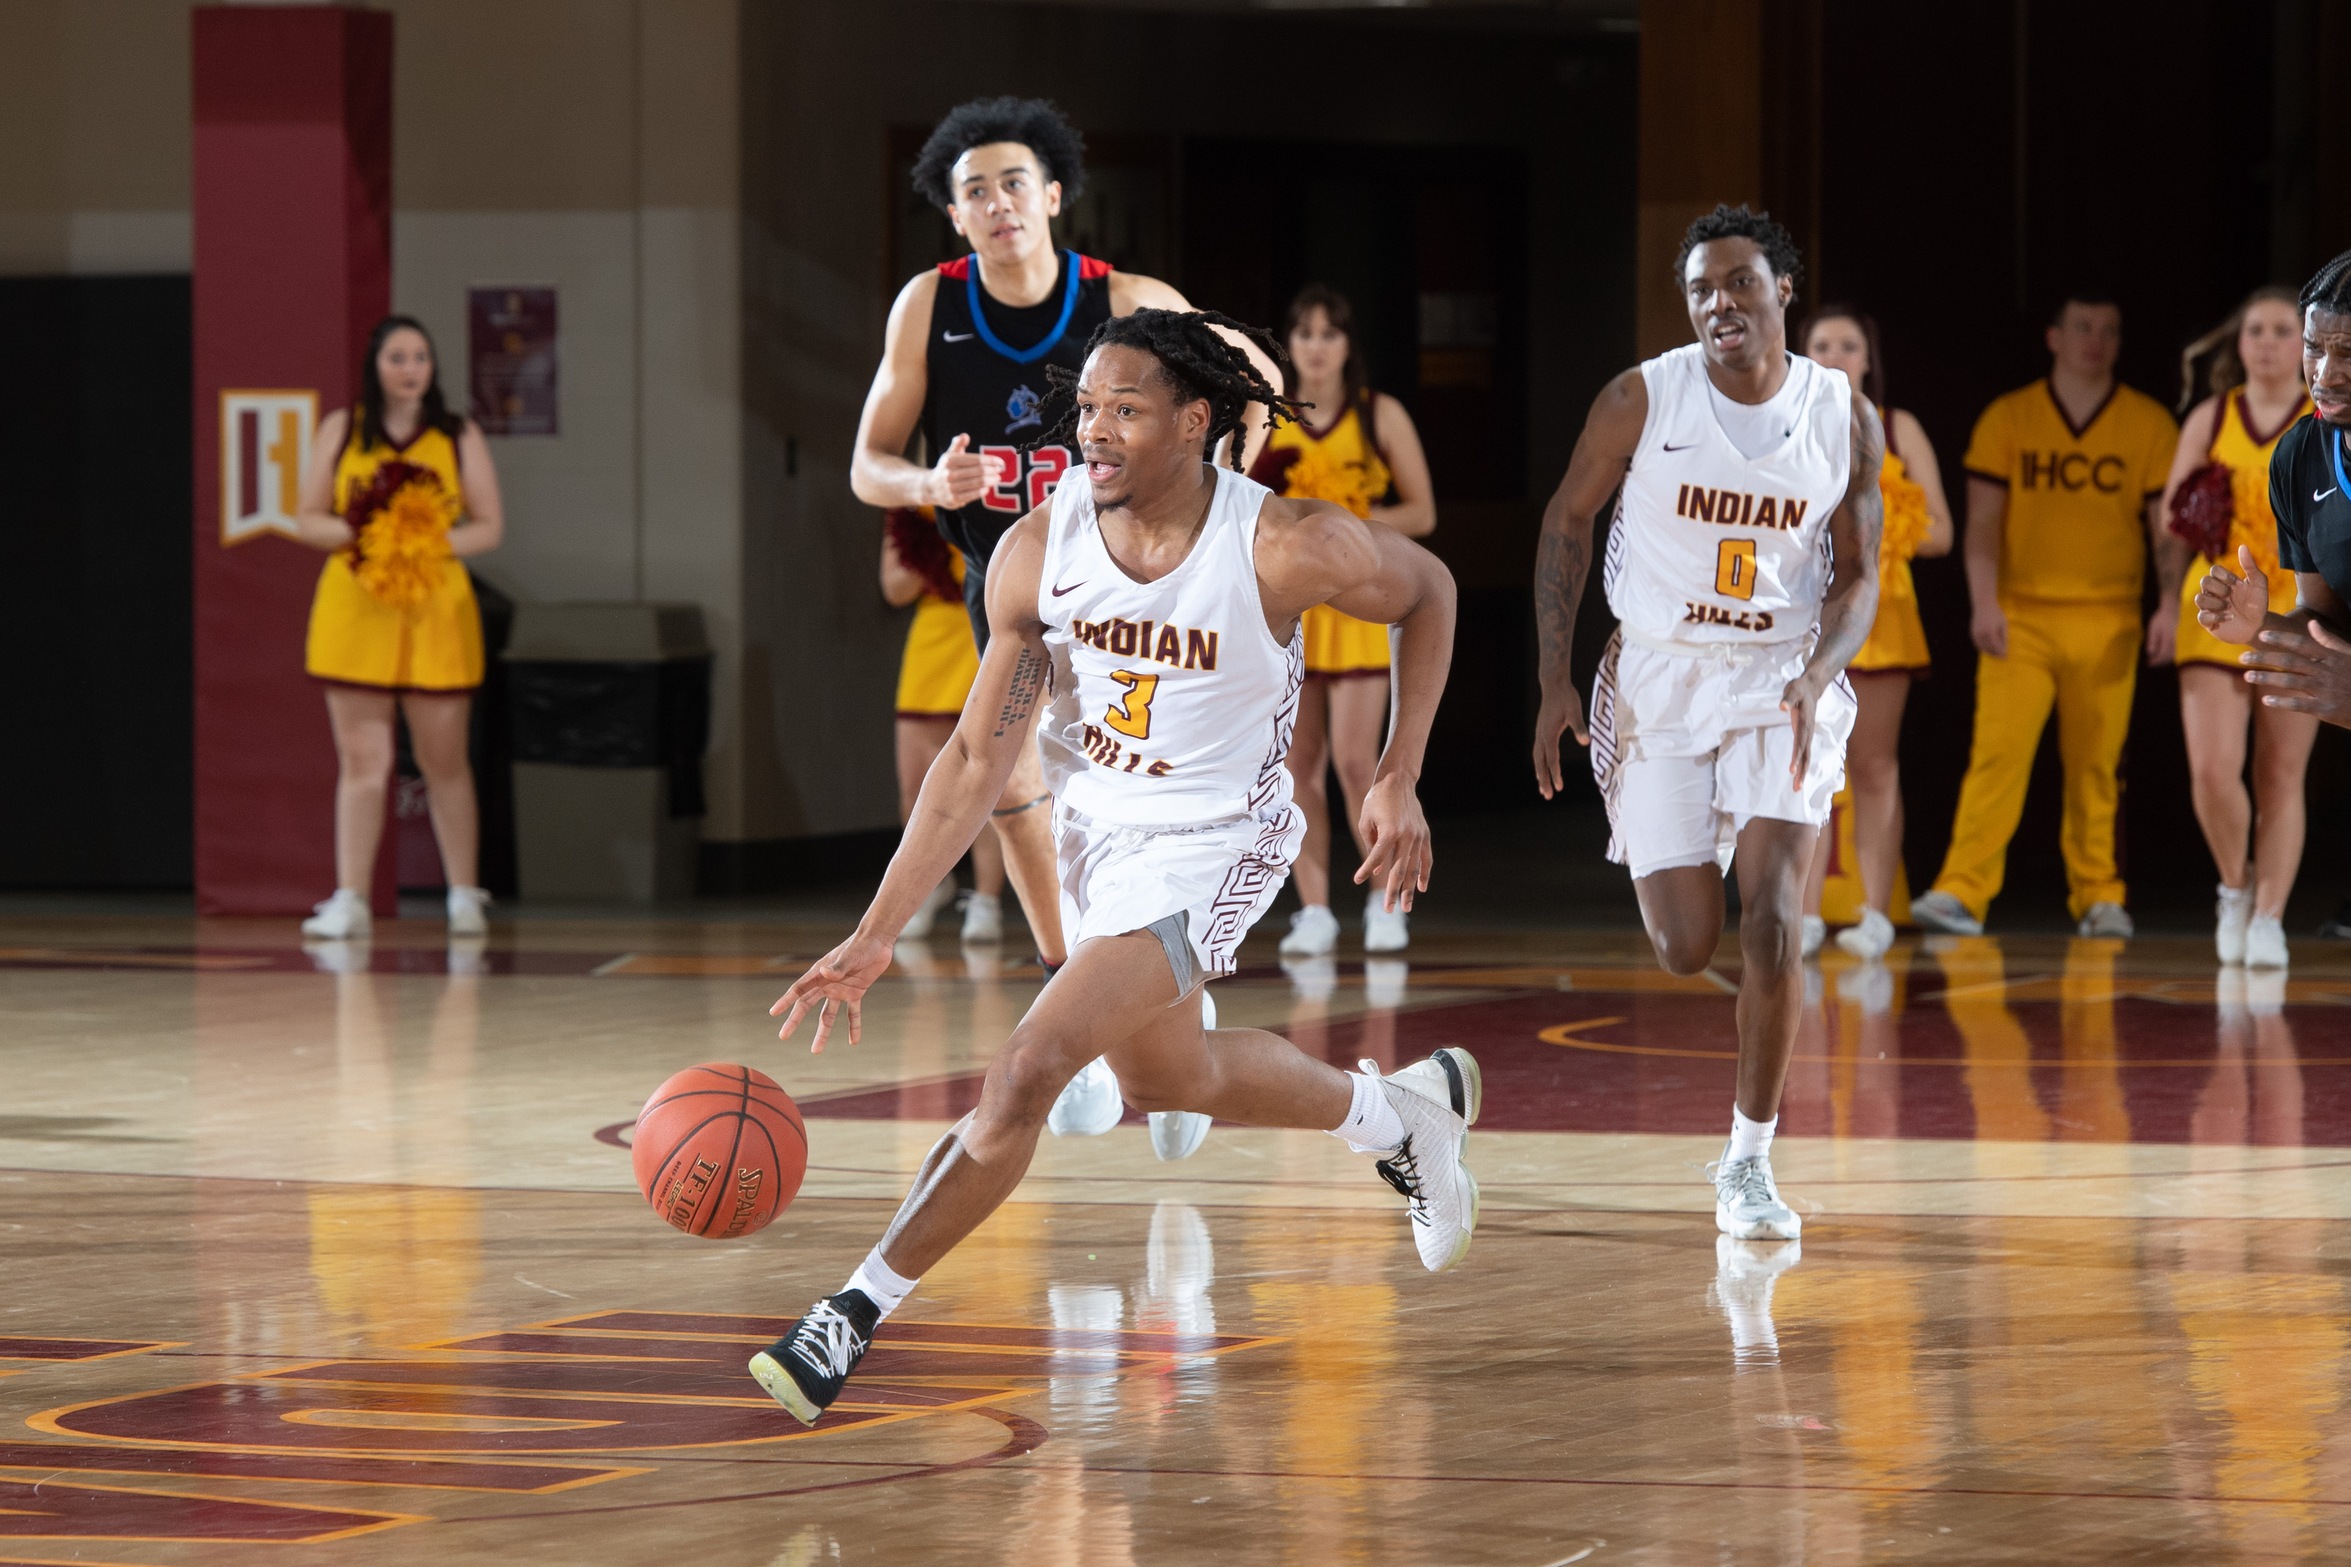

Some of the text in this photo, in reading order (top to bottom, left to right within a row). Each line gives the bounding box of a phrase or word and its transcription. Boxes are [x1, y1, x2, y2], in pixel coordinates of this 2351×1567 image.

[979, 445, 1072, 513] 22
[2021, 450, 2126, 493] IHCC
[1676, 484, 1808, 530] INDIAN
[1715, 538, 1758, 601] 0
[1072, 618, 1219, 672] INDIAN
[1104, 669, 1160, 740] 3
